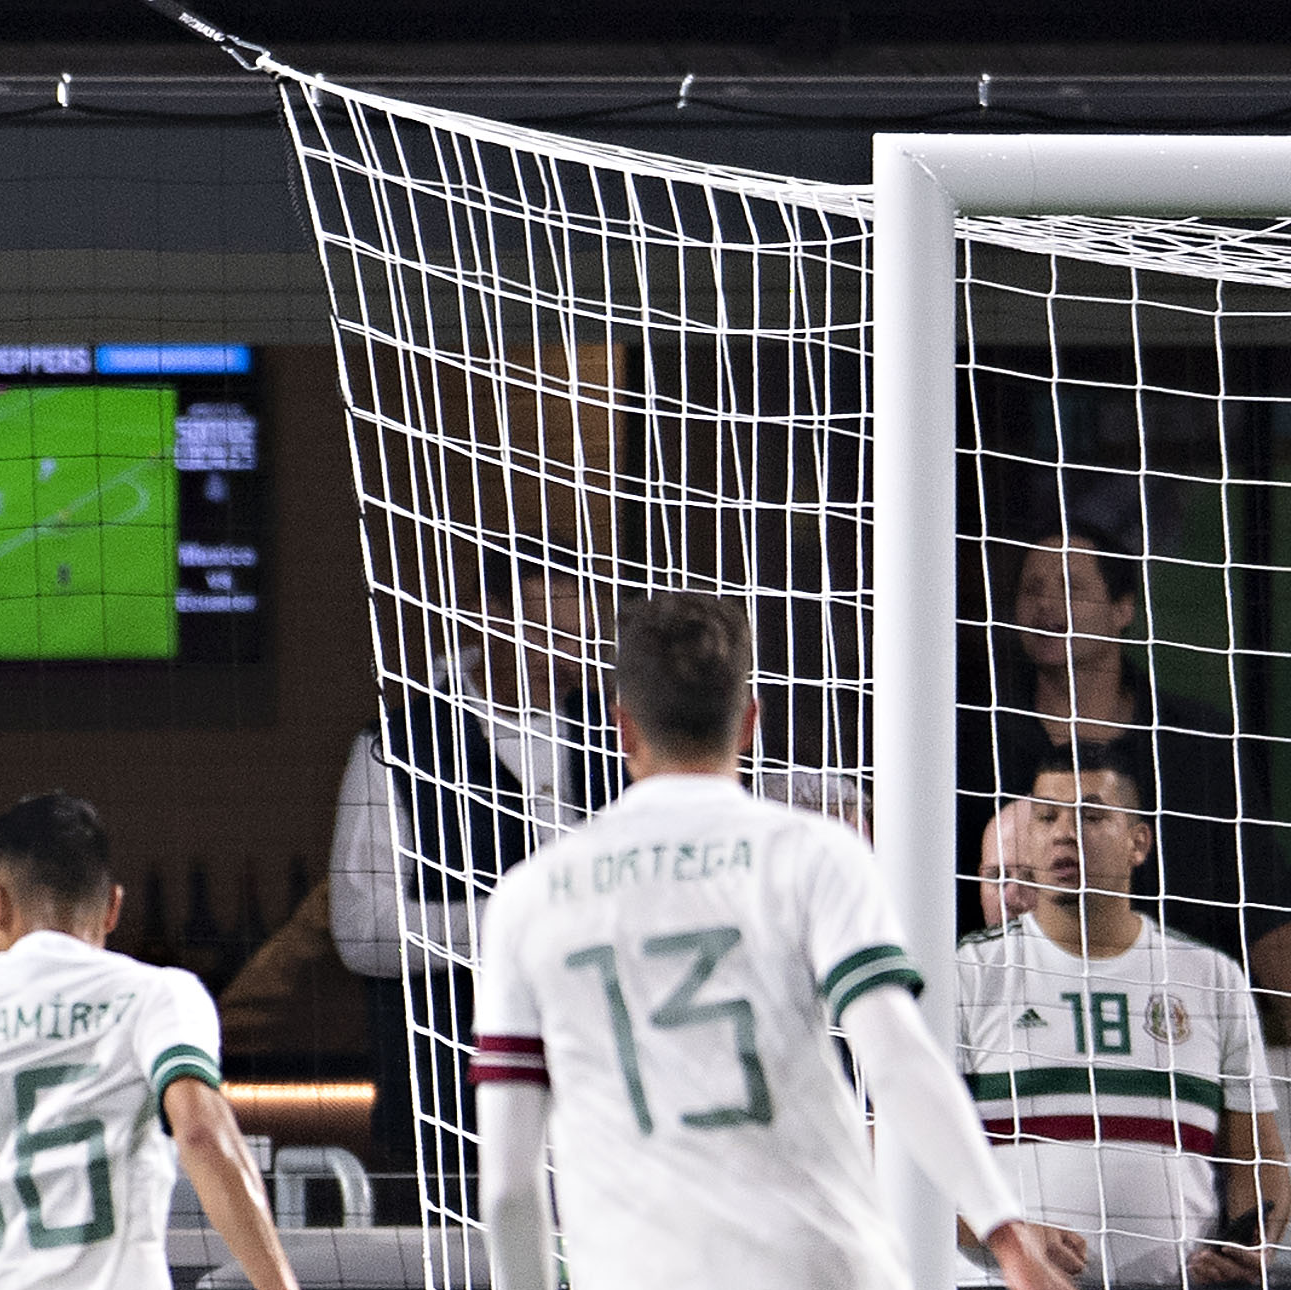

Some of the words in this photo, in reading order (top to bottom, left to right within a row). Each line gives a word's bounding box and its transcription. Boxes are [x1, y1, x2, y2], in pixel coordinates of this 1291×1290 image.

[593, 838, 752, 894] ORTEGA
[565, 926, 775, 1136] 13
[1060, 992, 1132, 1055] 18
